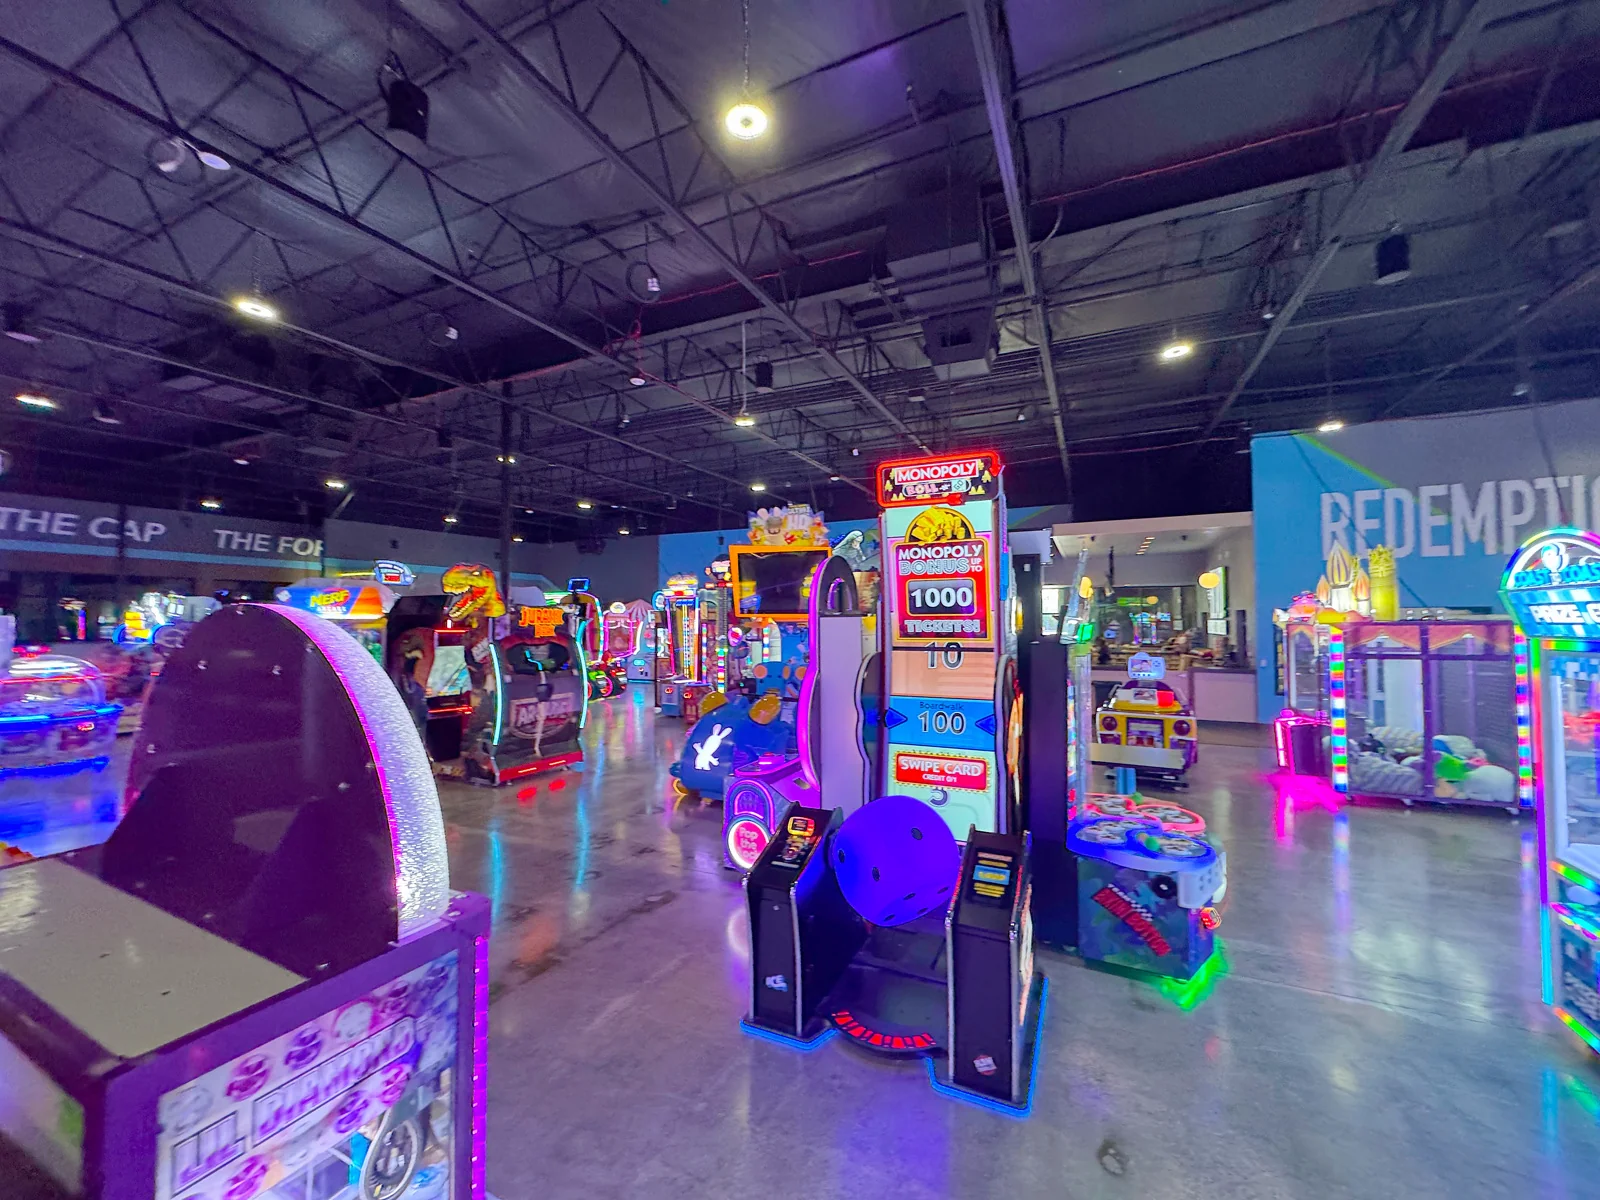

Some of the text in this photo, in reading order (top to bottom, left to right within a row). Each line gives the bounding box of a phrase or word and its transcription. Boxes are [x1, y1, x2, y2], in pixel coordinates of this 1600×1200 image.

[897, 462, 976, 482] MONOPOLY
[906, 483, 939, 496] ROLL
[0, 506, 80, 536] THE
[1320, 474, 1600, 561] REDEMPTI
[213, 529, 272, 552] THE
[898, 545, 982, 560] MONOPOLY
[899, 558, 969, 575] BONUS
[970, 565, 983, 573] TO
[971, 558, 982, 566] UP
[310, 588, 350, 607] NERF
[910, 587, 973, 608] 1000
[1529, 603, 1586, 624] PRIZE
[904, 619, 980, 633] TICKETS!
[925, 641, 964, 669] 10
[919, 701, 965, 711] Boardwalk
[918, 711, 967, 735] 100
[900, 758, 982, 777] SWIPE CARD
[922, 773, 945, 781] CREDIT
[739, 827, 759, 841] Pop
[740, 838, 758, 849] the
